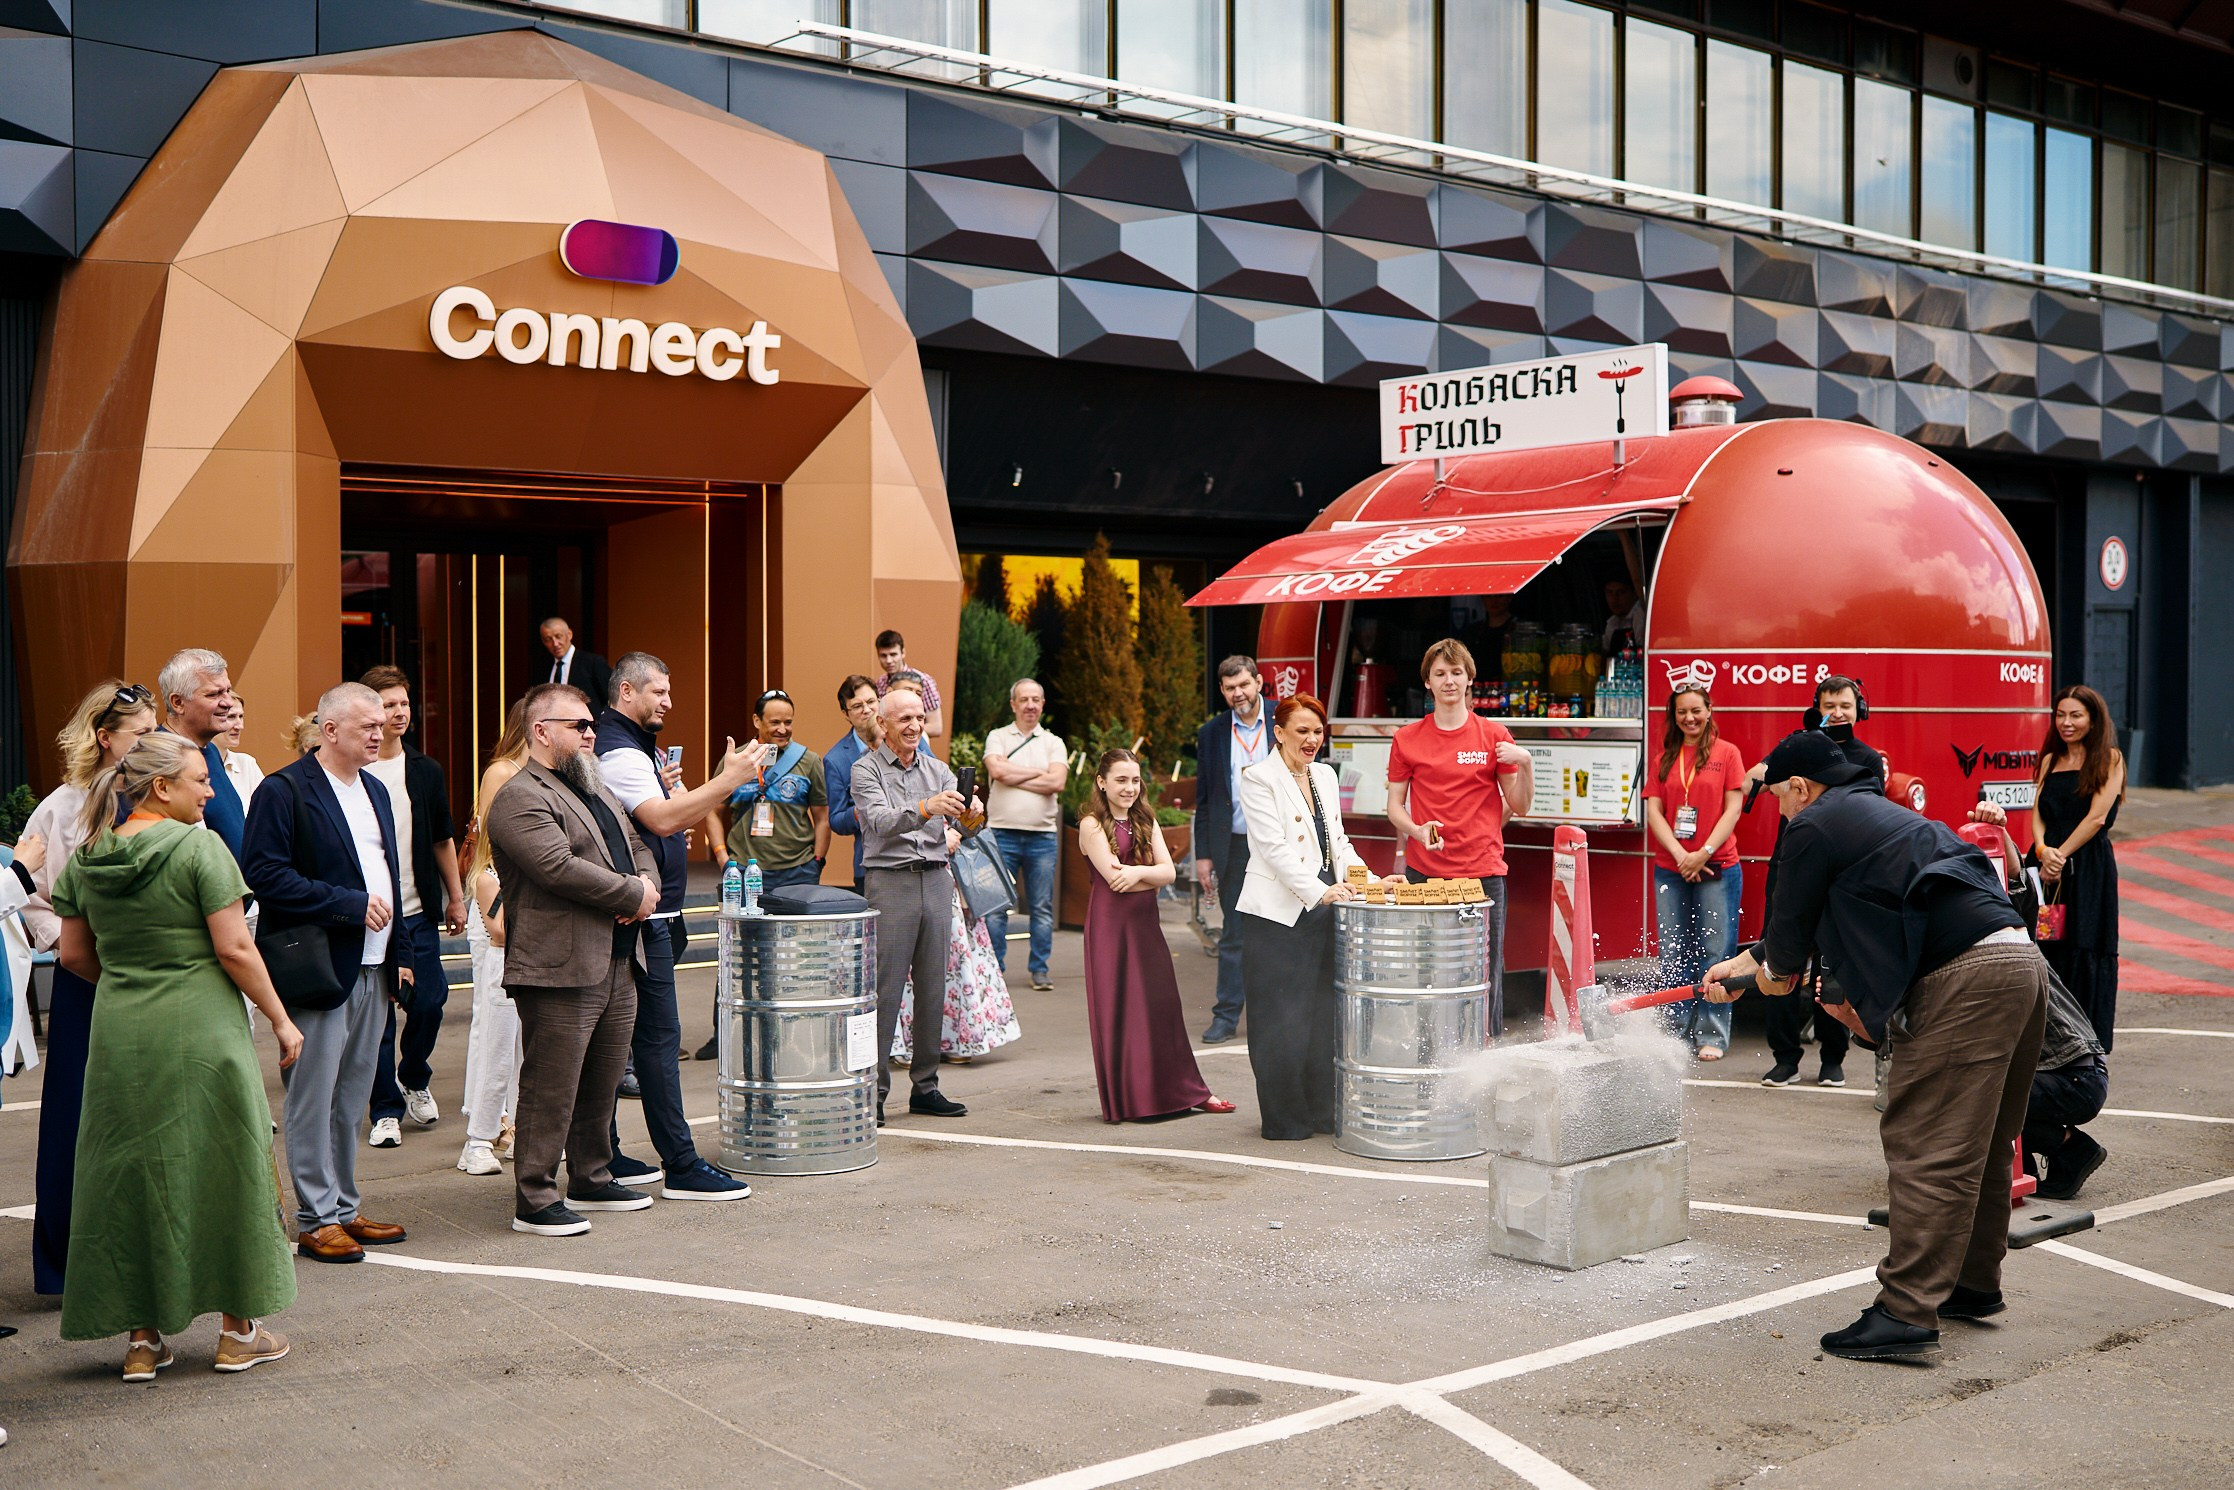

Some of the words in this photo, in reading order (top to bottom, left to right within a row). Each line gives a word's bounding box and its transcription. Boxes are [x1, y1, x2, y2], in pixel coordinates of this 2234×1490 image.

[429, 285, 782, 386] Connect
[1265, 569, 1404, 596] КОФЕ
[1732, 664, 1807, 684] КОФЕ
[1814, 664, 1832, 684] &
[2000, 662, 2036, 684] КОФЕ
[1457, 757, 1487, 765] ФОРУМ
